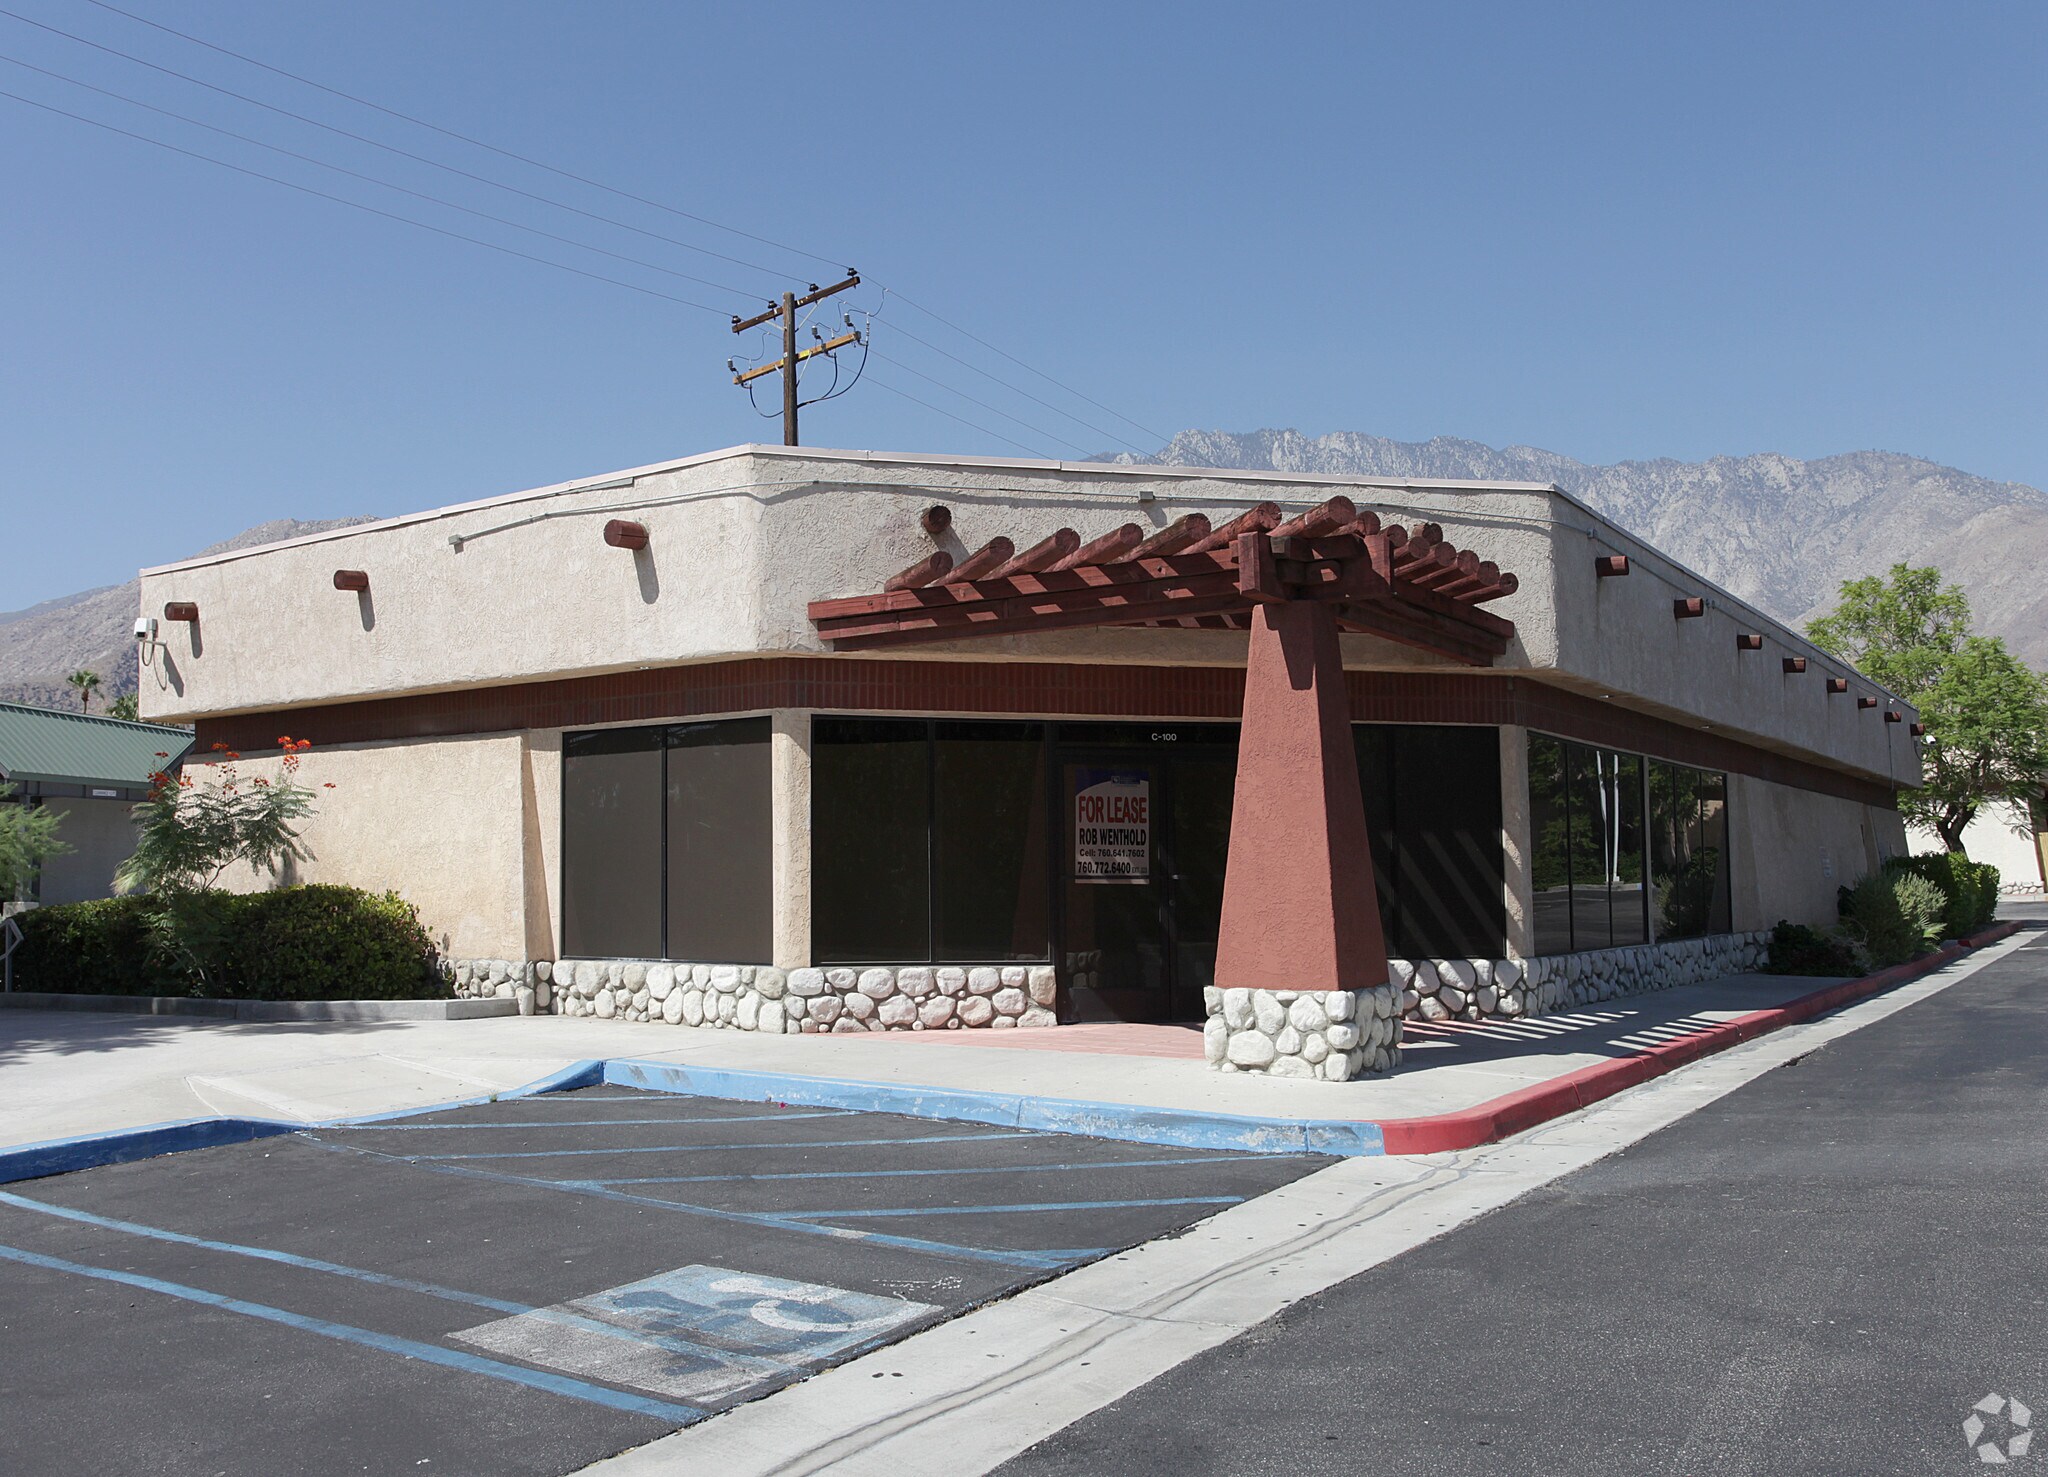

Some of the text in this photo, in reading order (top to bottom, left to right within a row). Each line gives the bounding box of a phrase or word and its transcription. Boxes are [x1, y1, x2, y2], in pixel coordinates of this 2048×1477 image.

[1151, 733, 1177, 741] C-100
[1078, 796, 1147, 824] FOR LEASE
[1079, 828, 1146, 846] ROB WENTHOLD
[1080, 849, 1145, 857] Cell: 760.641.7602
[1077, 861, 1131, 874] 760.772.6400
